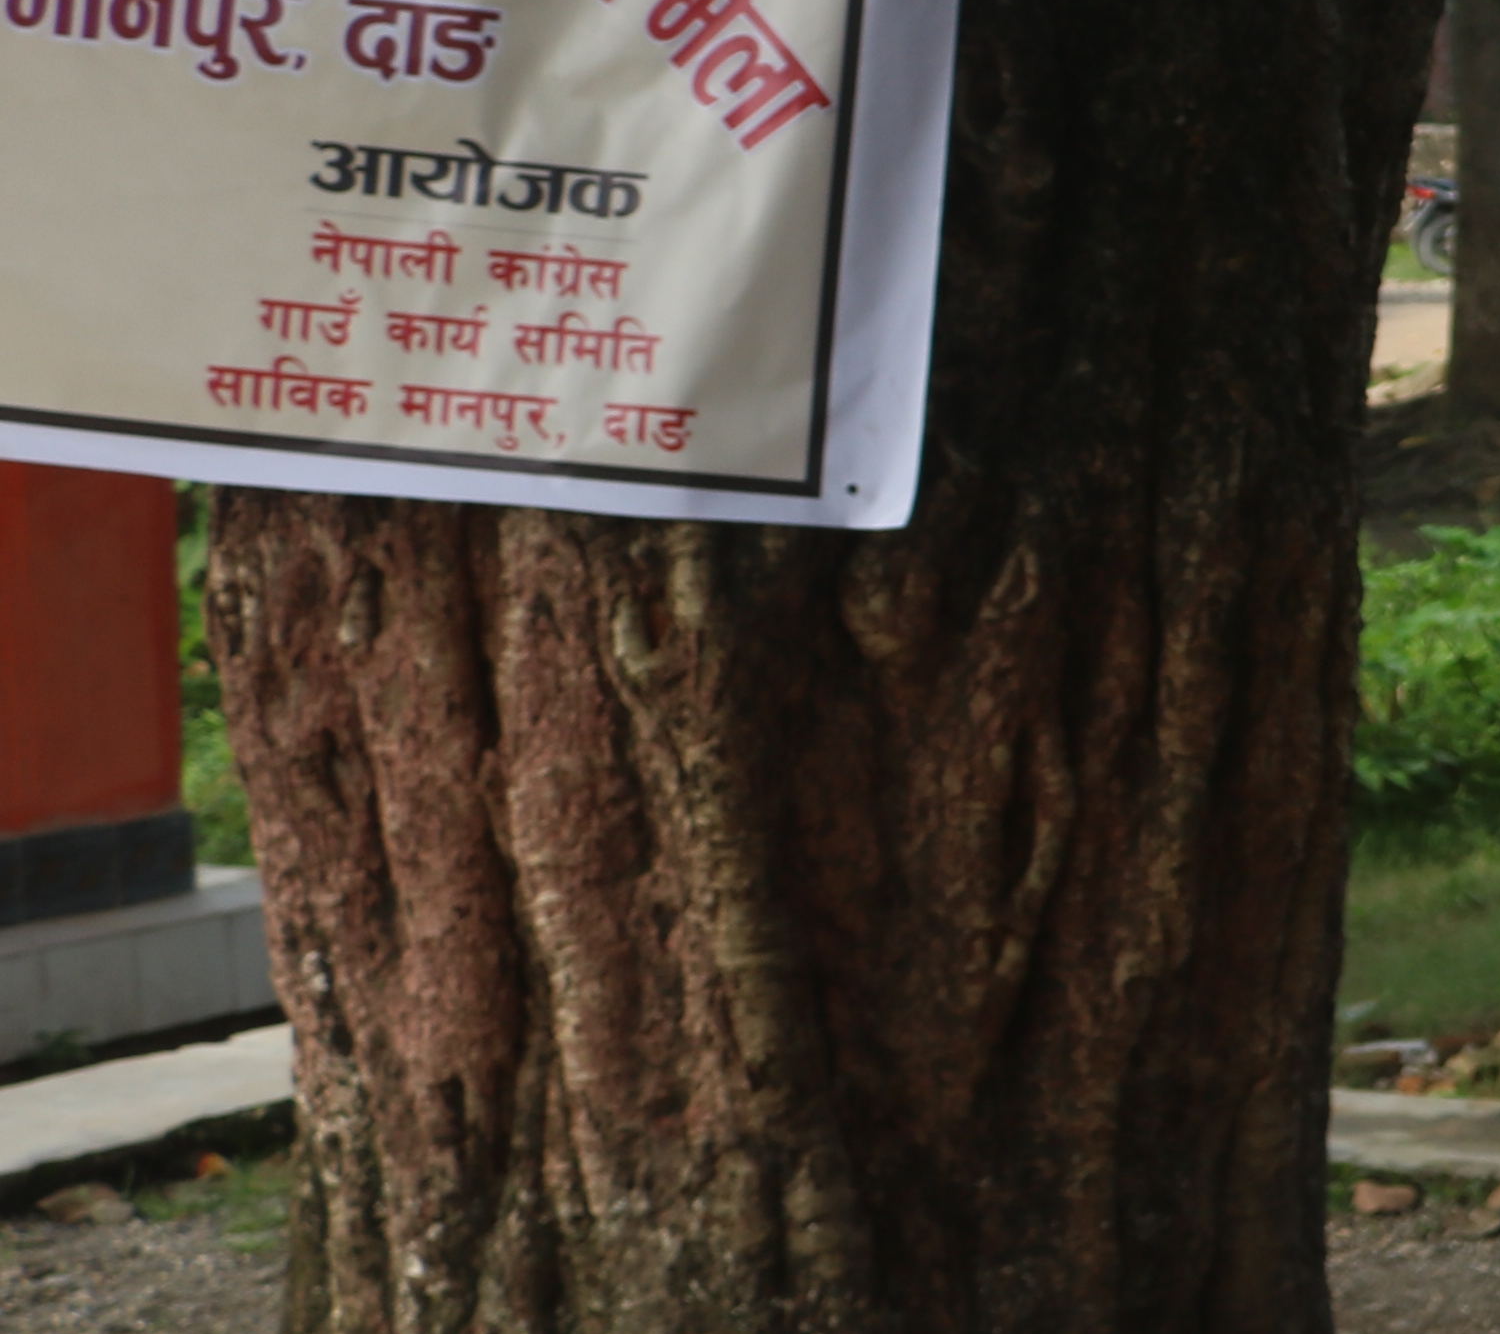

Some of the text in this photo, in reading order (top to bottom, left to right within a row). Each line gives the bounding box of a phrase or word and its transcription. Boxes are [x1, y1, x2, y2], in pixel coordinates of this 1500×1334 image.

[308, 138, 650, 219] आयोजक
[311, 219, 630, 300] नेपाली कांग्रेस
[257, 289, 663, 373] गाउँ कार्य समिति
[206, 354, 698, 452] साविक मानपुर, दाङ
